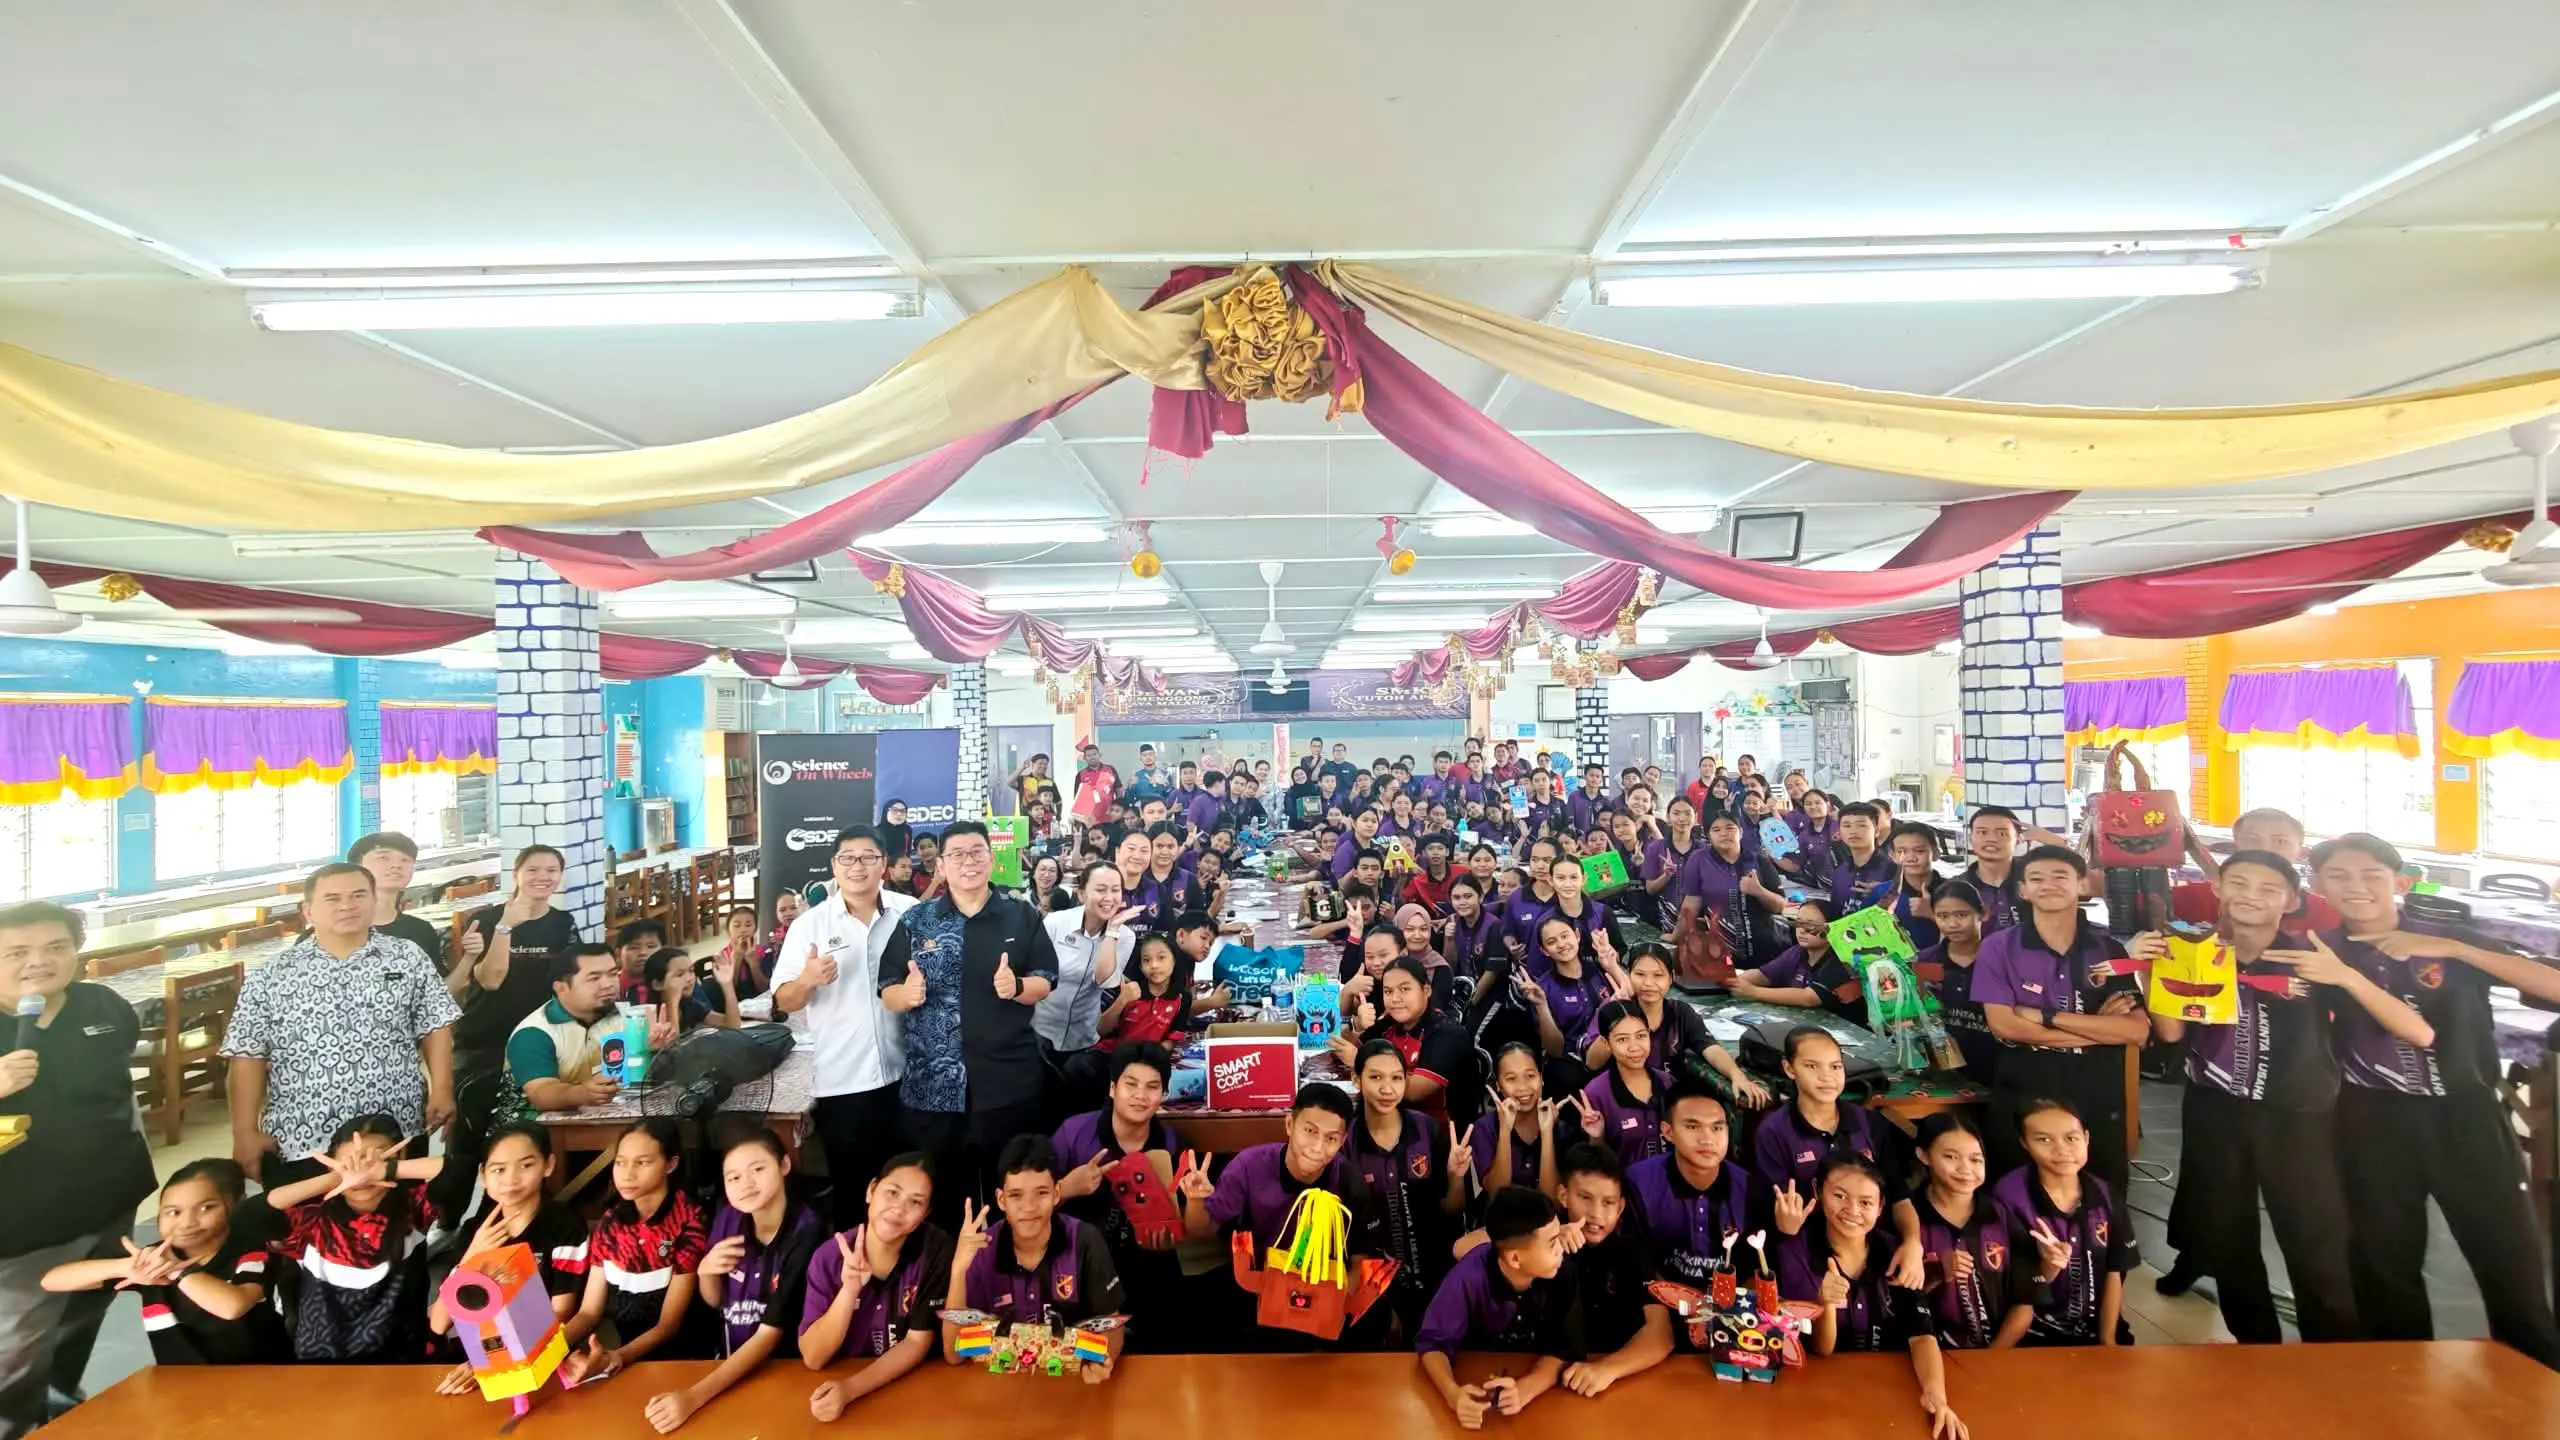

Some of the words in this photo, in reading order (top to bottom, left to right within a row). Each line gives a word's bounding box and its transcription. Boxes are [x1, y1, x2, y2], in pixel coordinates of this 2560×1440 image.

[791, 758, 849, 772] Science
[795, 770, 817, 782] On
[823, 767, 873, 781] Wheels
[906, 804, 955, 823] SDEC
[805, 829, 841, 844] SDE
[1259, 976, 1272, 984] Go
[1223, 978, 1272, 1003] Gree
[2257, 1001, 2271, 1052] LAKINTA
[1213, 1051, 1262, 1078] SMART
[1216, 1069, 1249, 1089] COPY
